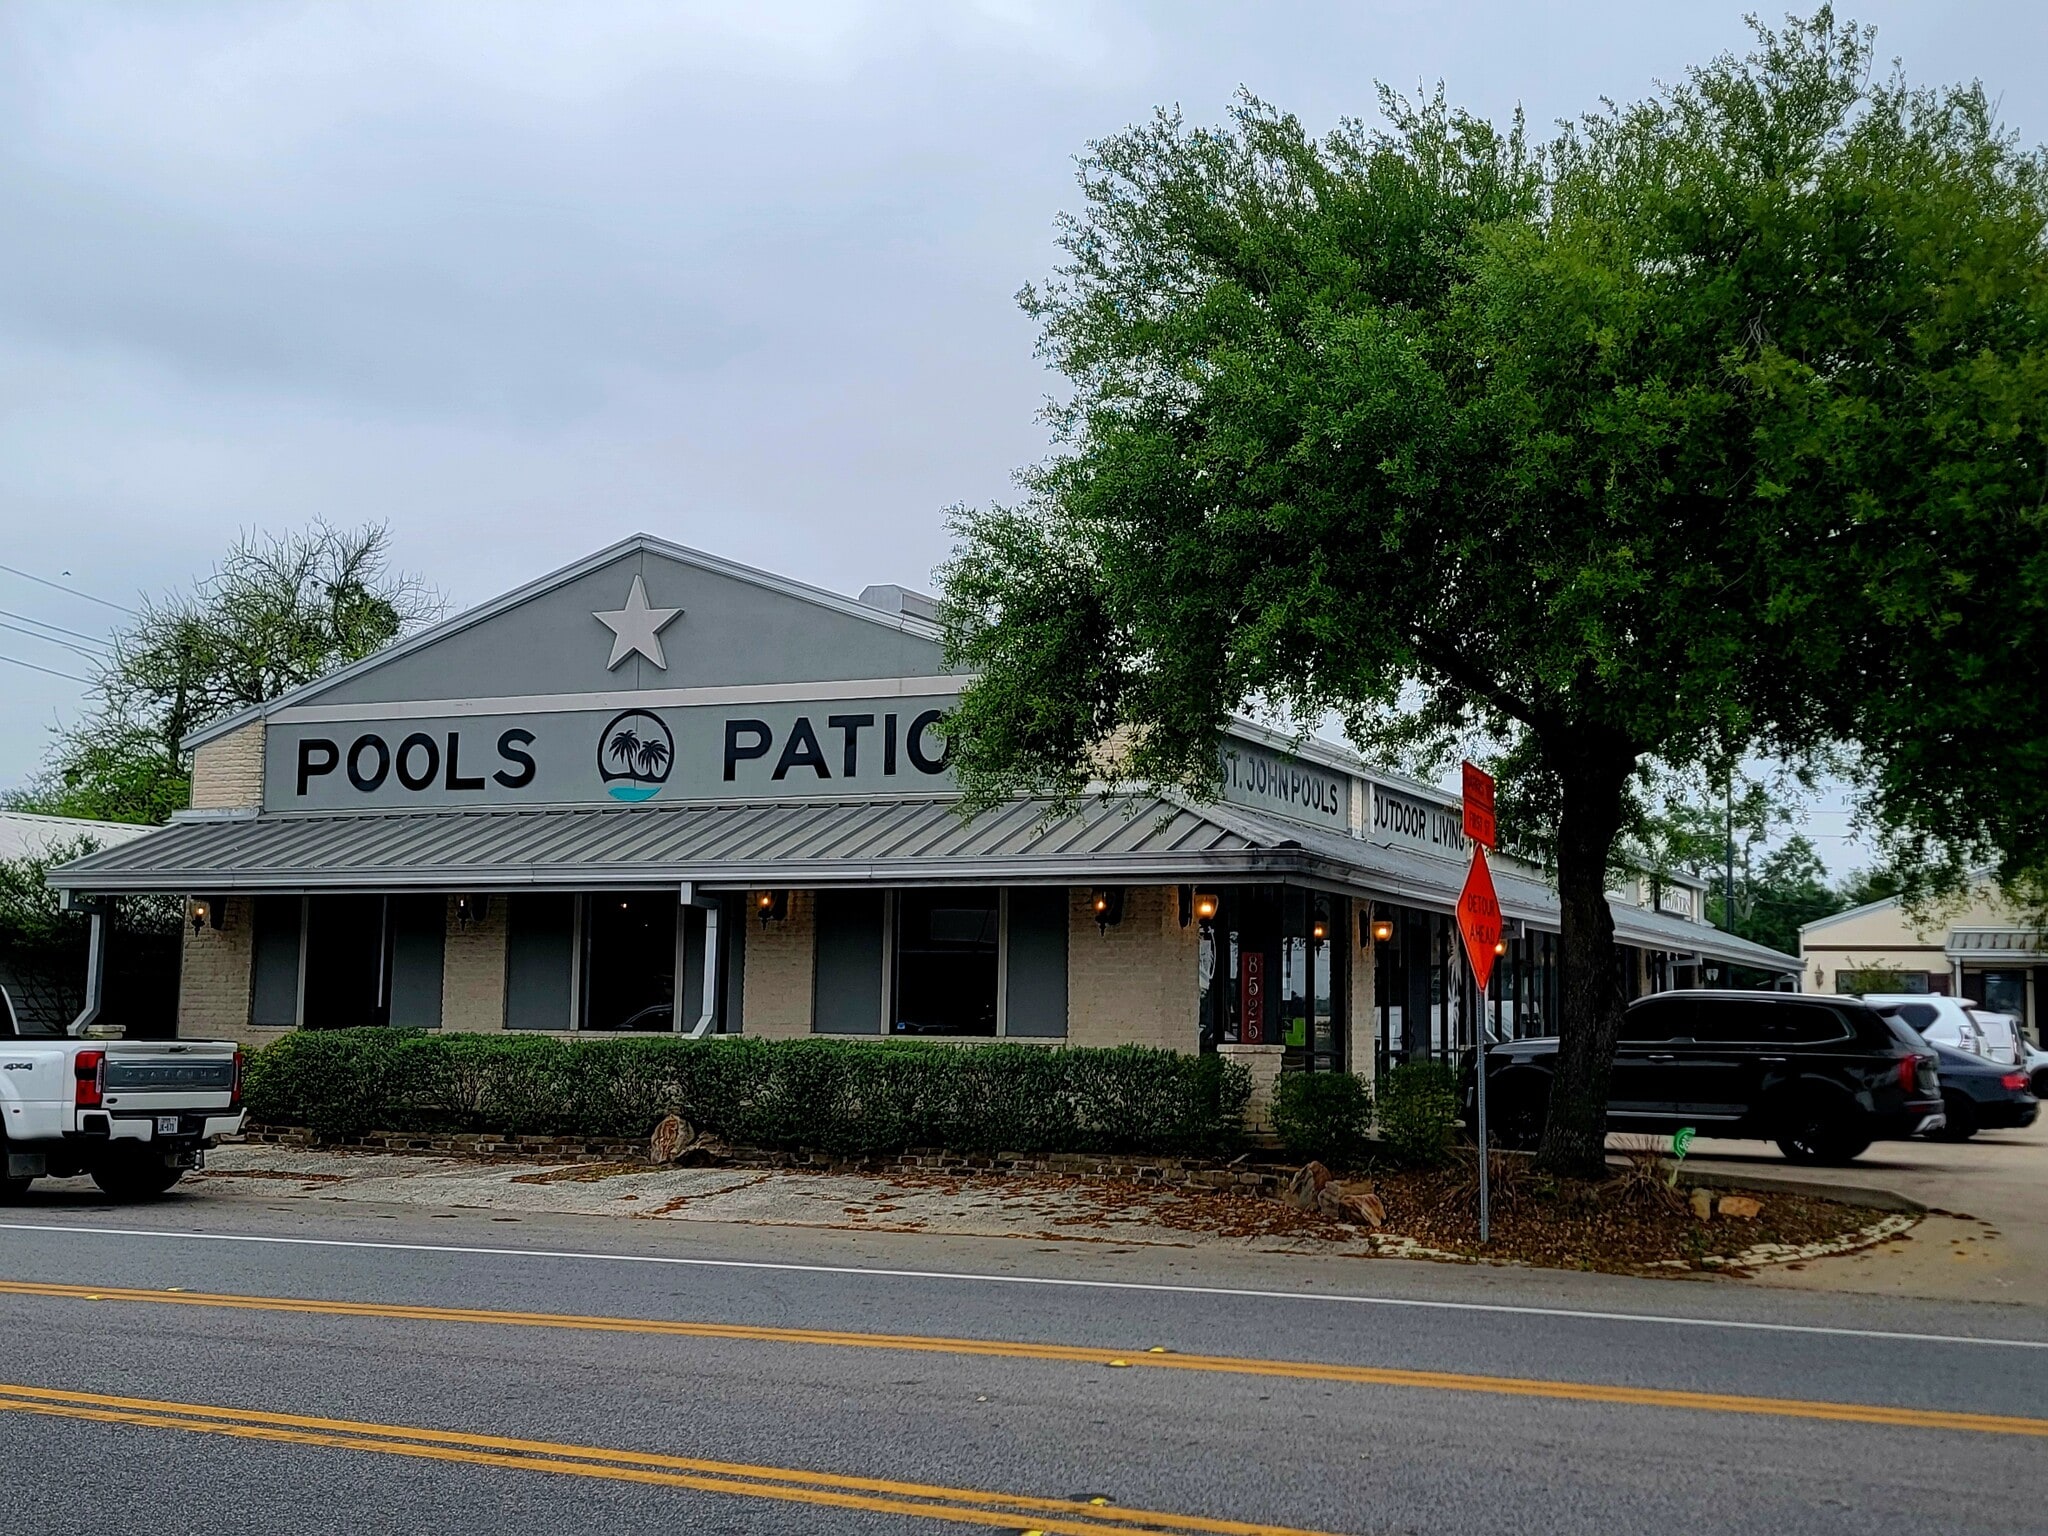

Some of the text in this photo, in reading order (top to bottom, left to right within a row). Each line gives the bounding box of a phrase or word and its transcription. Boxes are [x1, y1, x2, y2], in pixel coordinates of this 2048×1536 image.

[297, 728, 537, 796] POOLS
[1246, 757, 1288, 801] JOHN
[1291, 770, 1338, 815] POOLS
[1374, 793, 1464, 851] OUTDOOR LIVING
[1468, 893, 1495, 916] DETOUR
[1470, 923, 1495, 945] AHEAD
